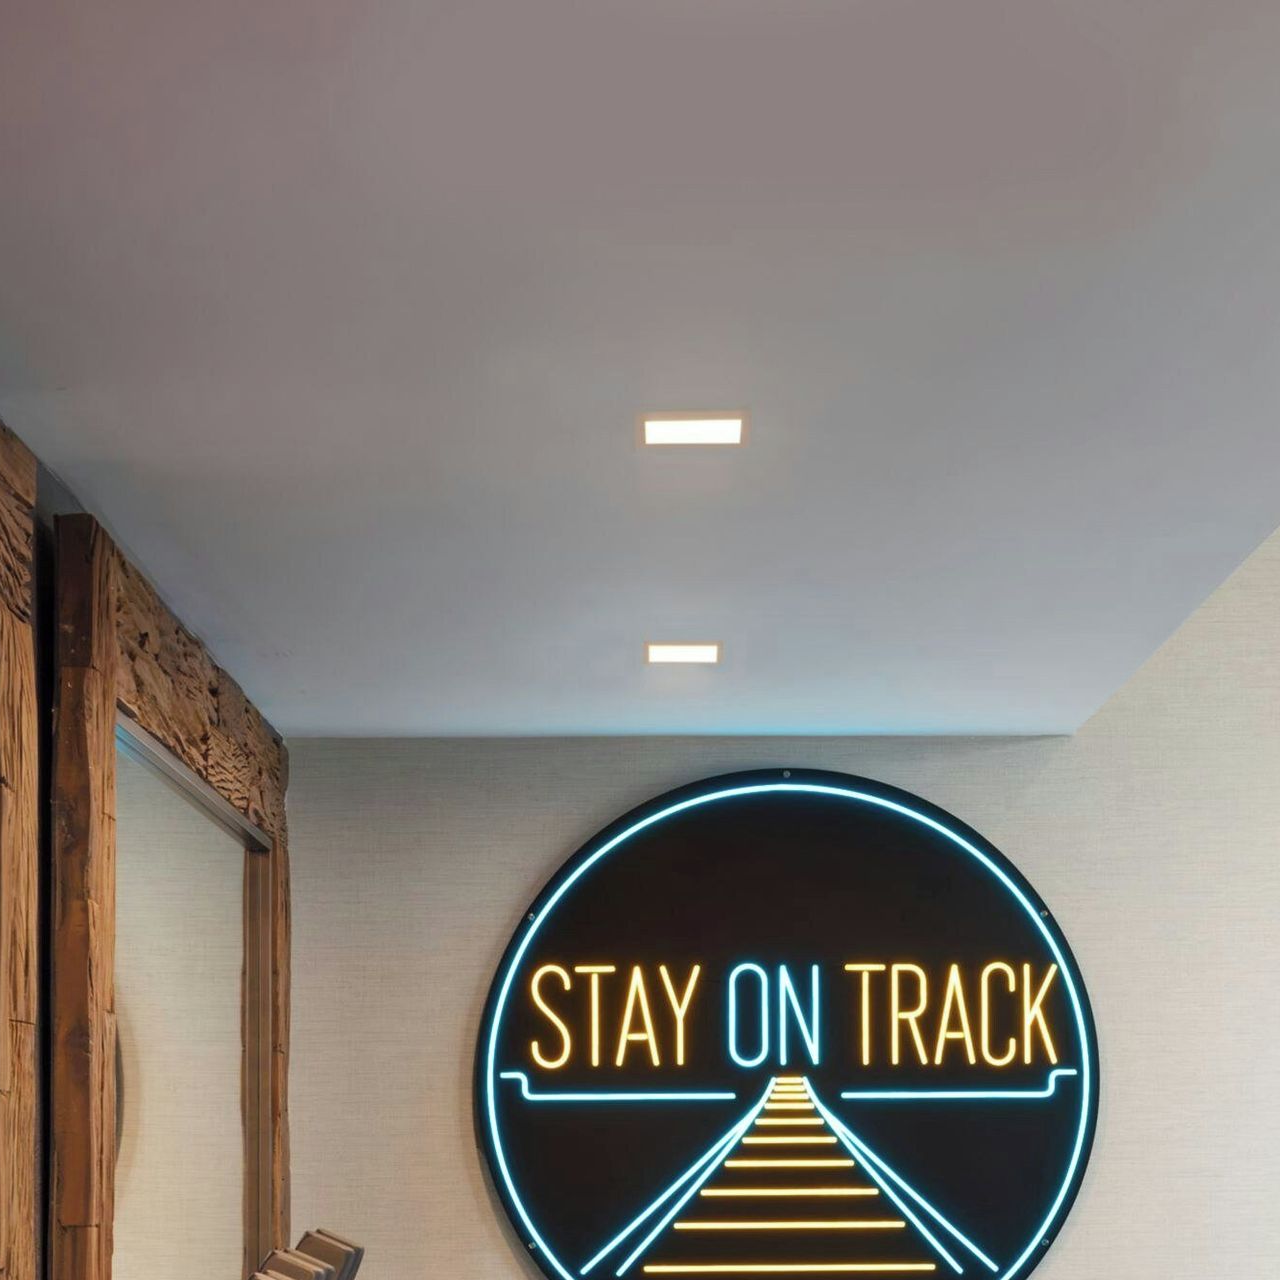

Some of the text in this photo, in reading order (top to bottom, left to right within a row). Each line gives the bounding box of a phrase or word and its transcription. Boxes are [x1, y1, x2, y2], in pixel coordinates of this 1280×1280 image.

[530, 961, 1058, 1070] STAY ON TRACK
